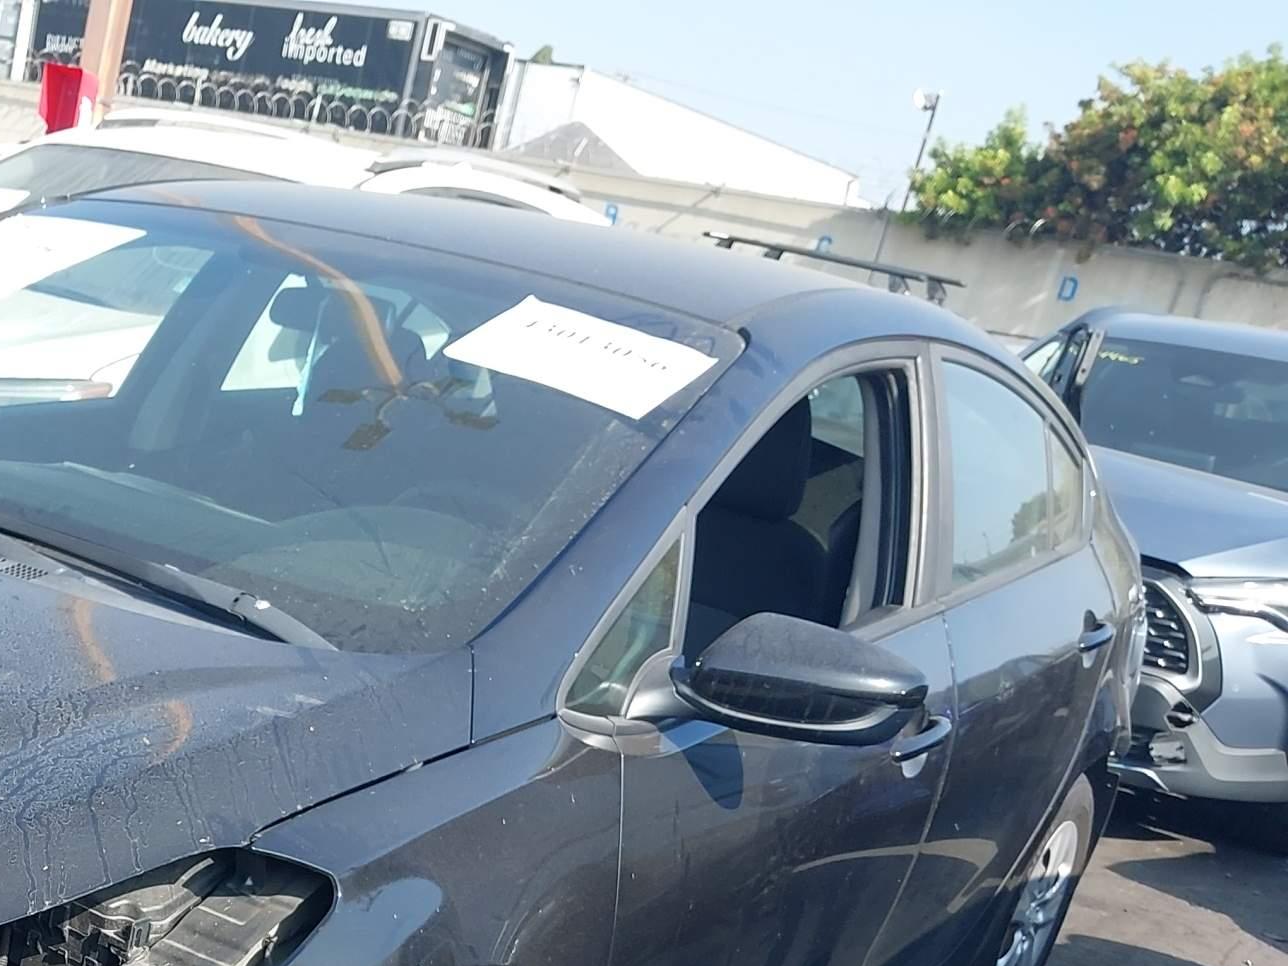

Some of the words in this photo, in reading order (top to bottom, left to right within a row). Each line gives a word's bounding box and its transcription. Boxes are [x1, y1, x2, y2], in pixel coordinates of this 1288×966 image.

[182, 11, 254, 61] bakery
[281, 36, 368, 67] imported
[1057, 276, 1078, 301] D
